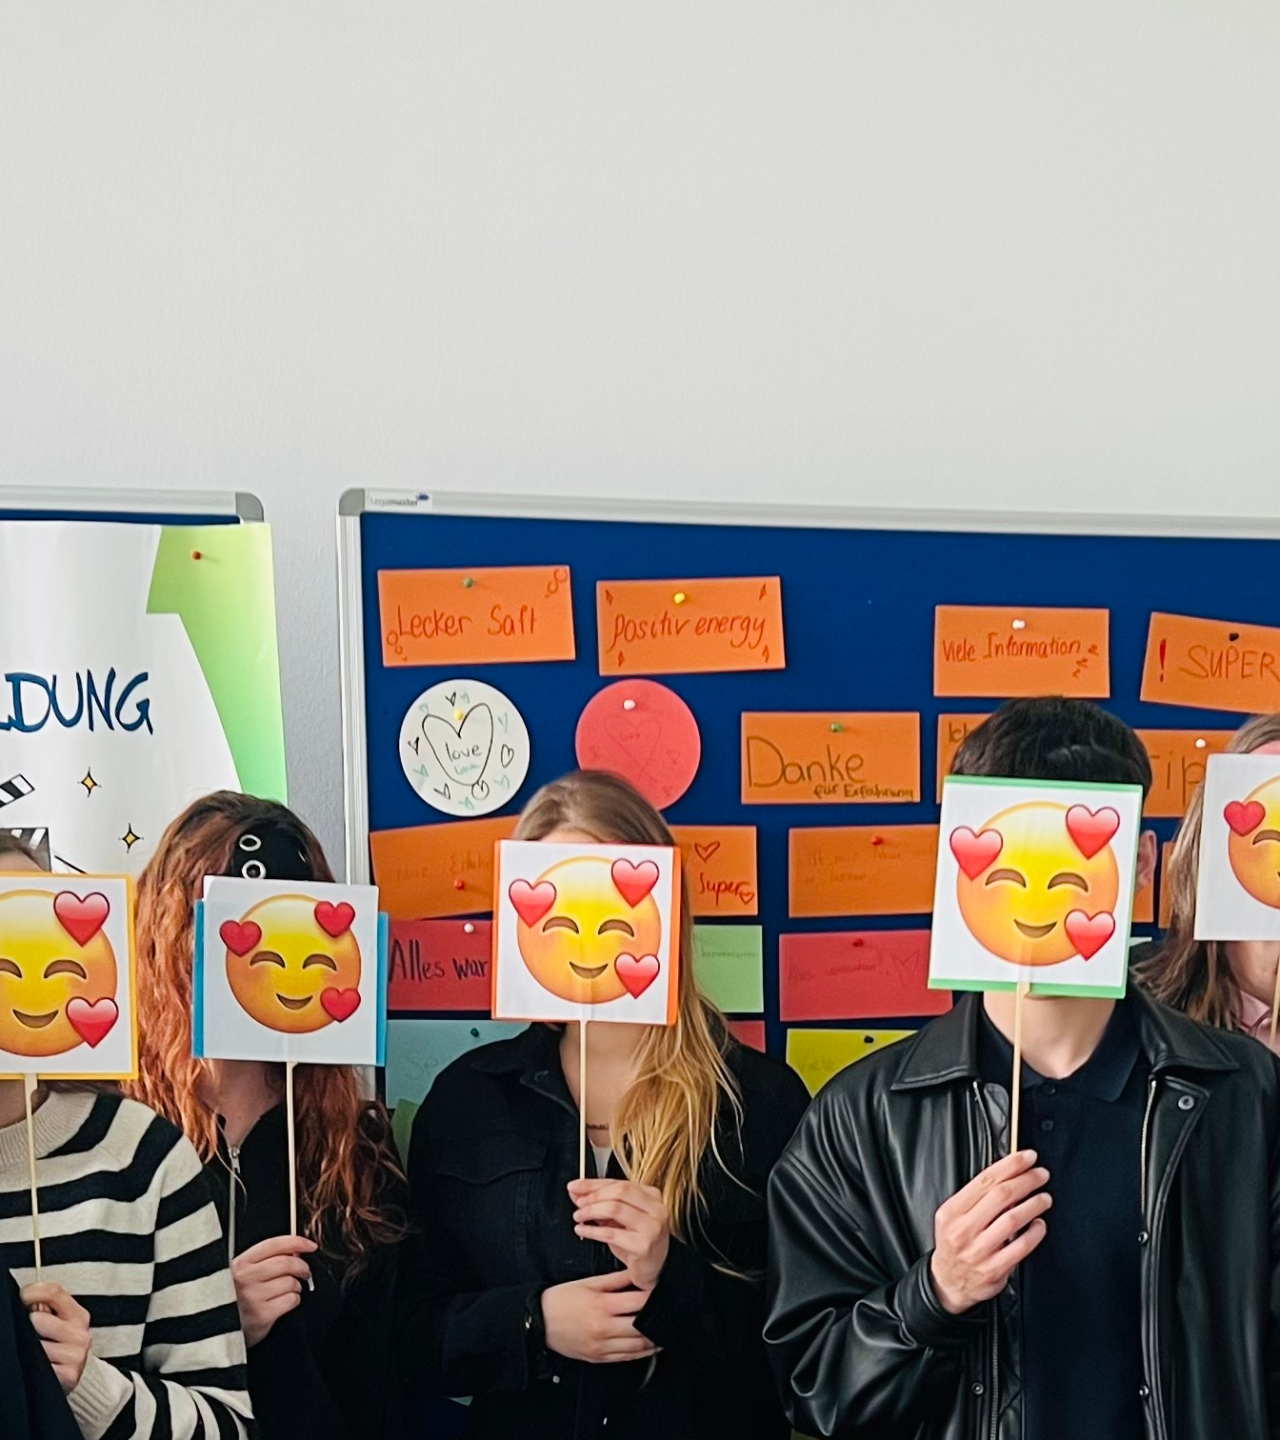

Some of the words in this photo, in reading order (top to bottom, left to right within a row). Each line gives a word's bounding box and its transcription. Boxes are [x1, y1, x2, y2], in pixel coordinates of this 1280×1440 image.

[397, 604, 472, 638] Lecker
[694, 615, 766, 650] energy
[982, 632, 1081, 659] Information
[1178, 643, 1280, 684] SUPER
[445, 741, 482, 762] love
[746, 735, 867, 788] Danke
[699, 872, 745, 907] Super
[389, 937, 446, 984] Alles
